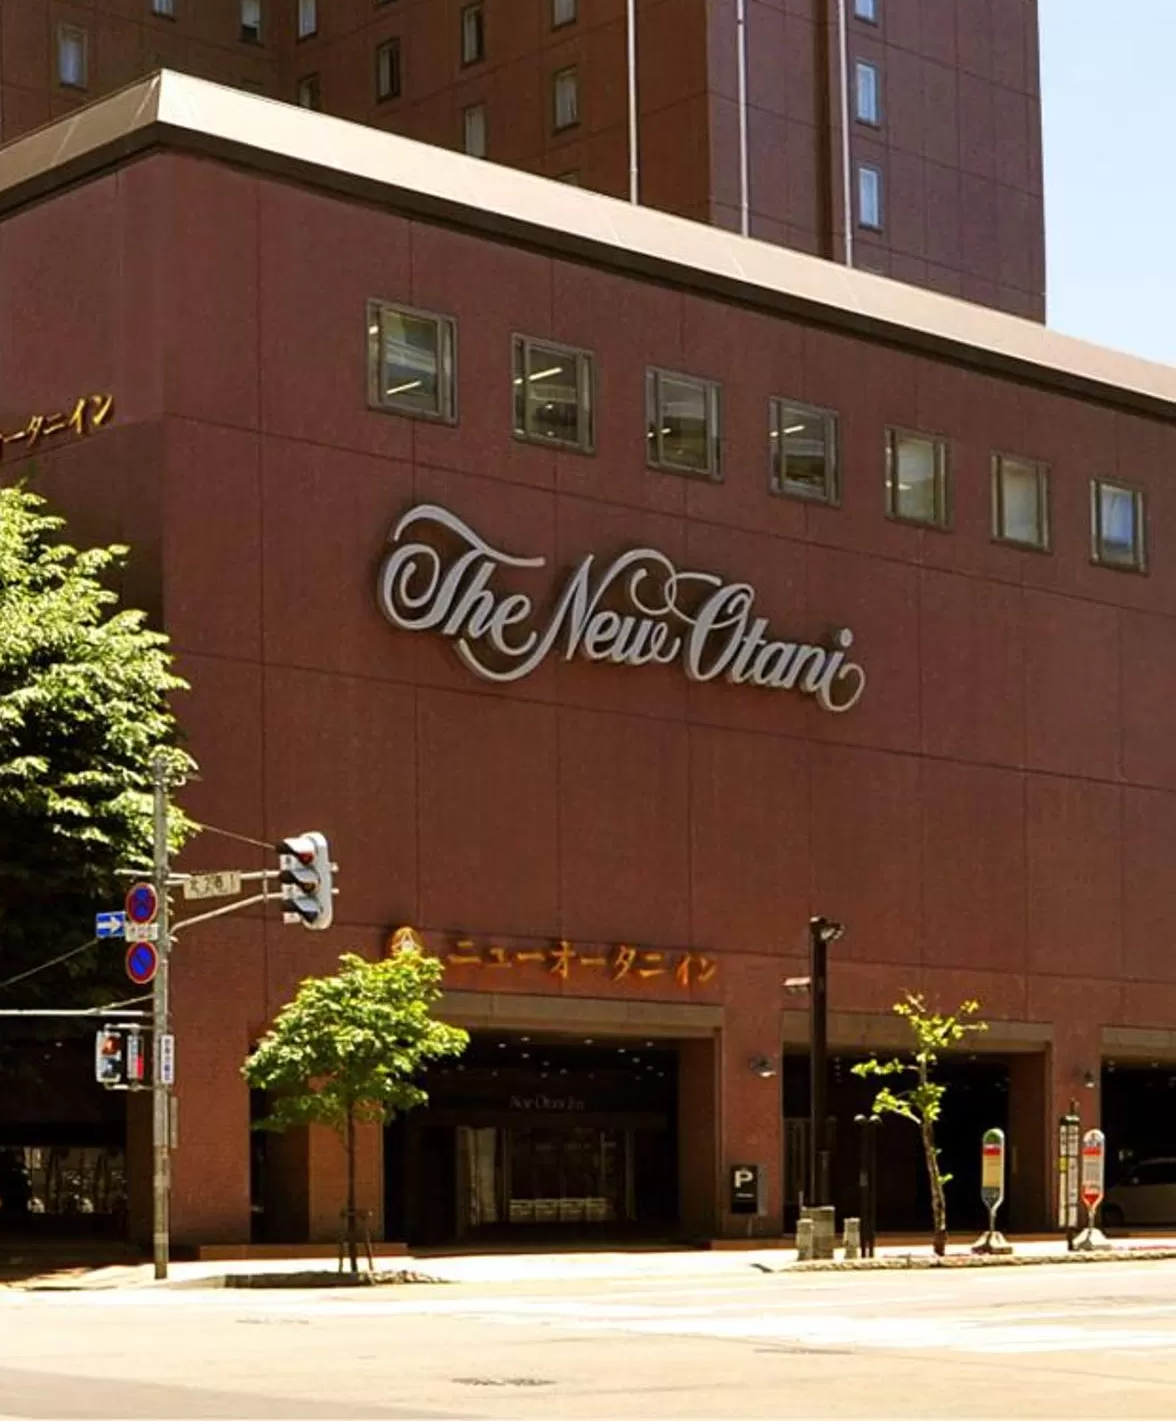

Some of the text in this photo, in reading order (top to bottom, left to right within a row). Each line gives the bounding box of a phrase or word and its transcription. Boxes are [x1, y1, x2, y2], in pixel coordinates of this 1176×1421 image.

[382, 504, 866, 712] The New Otani
[734, 1171, 753, 1189] P
